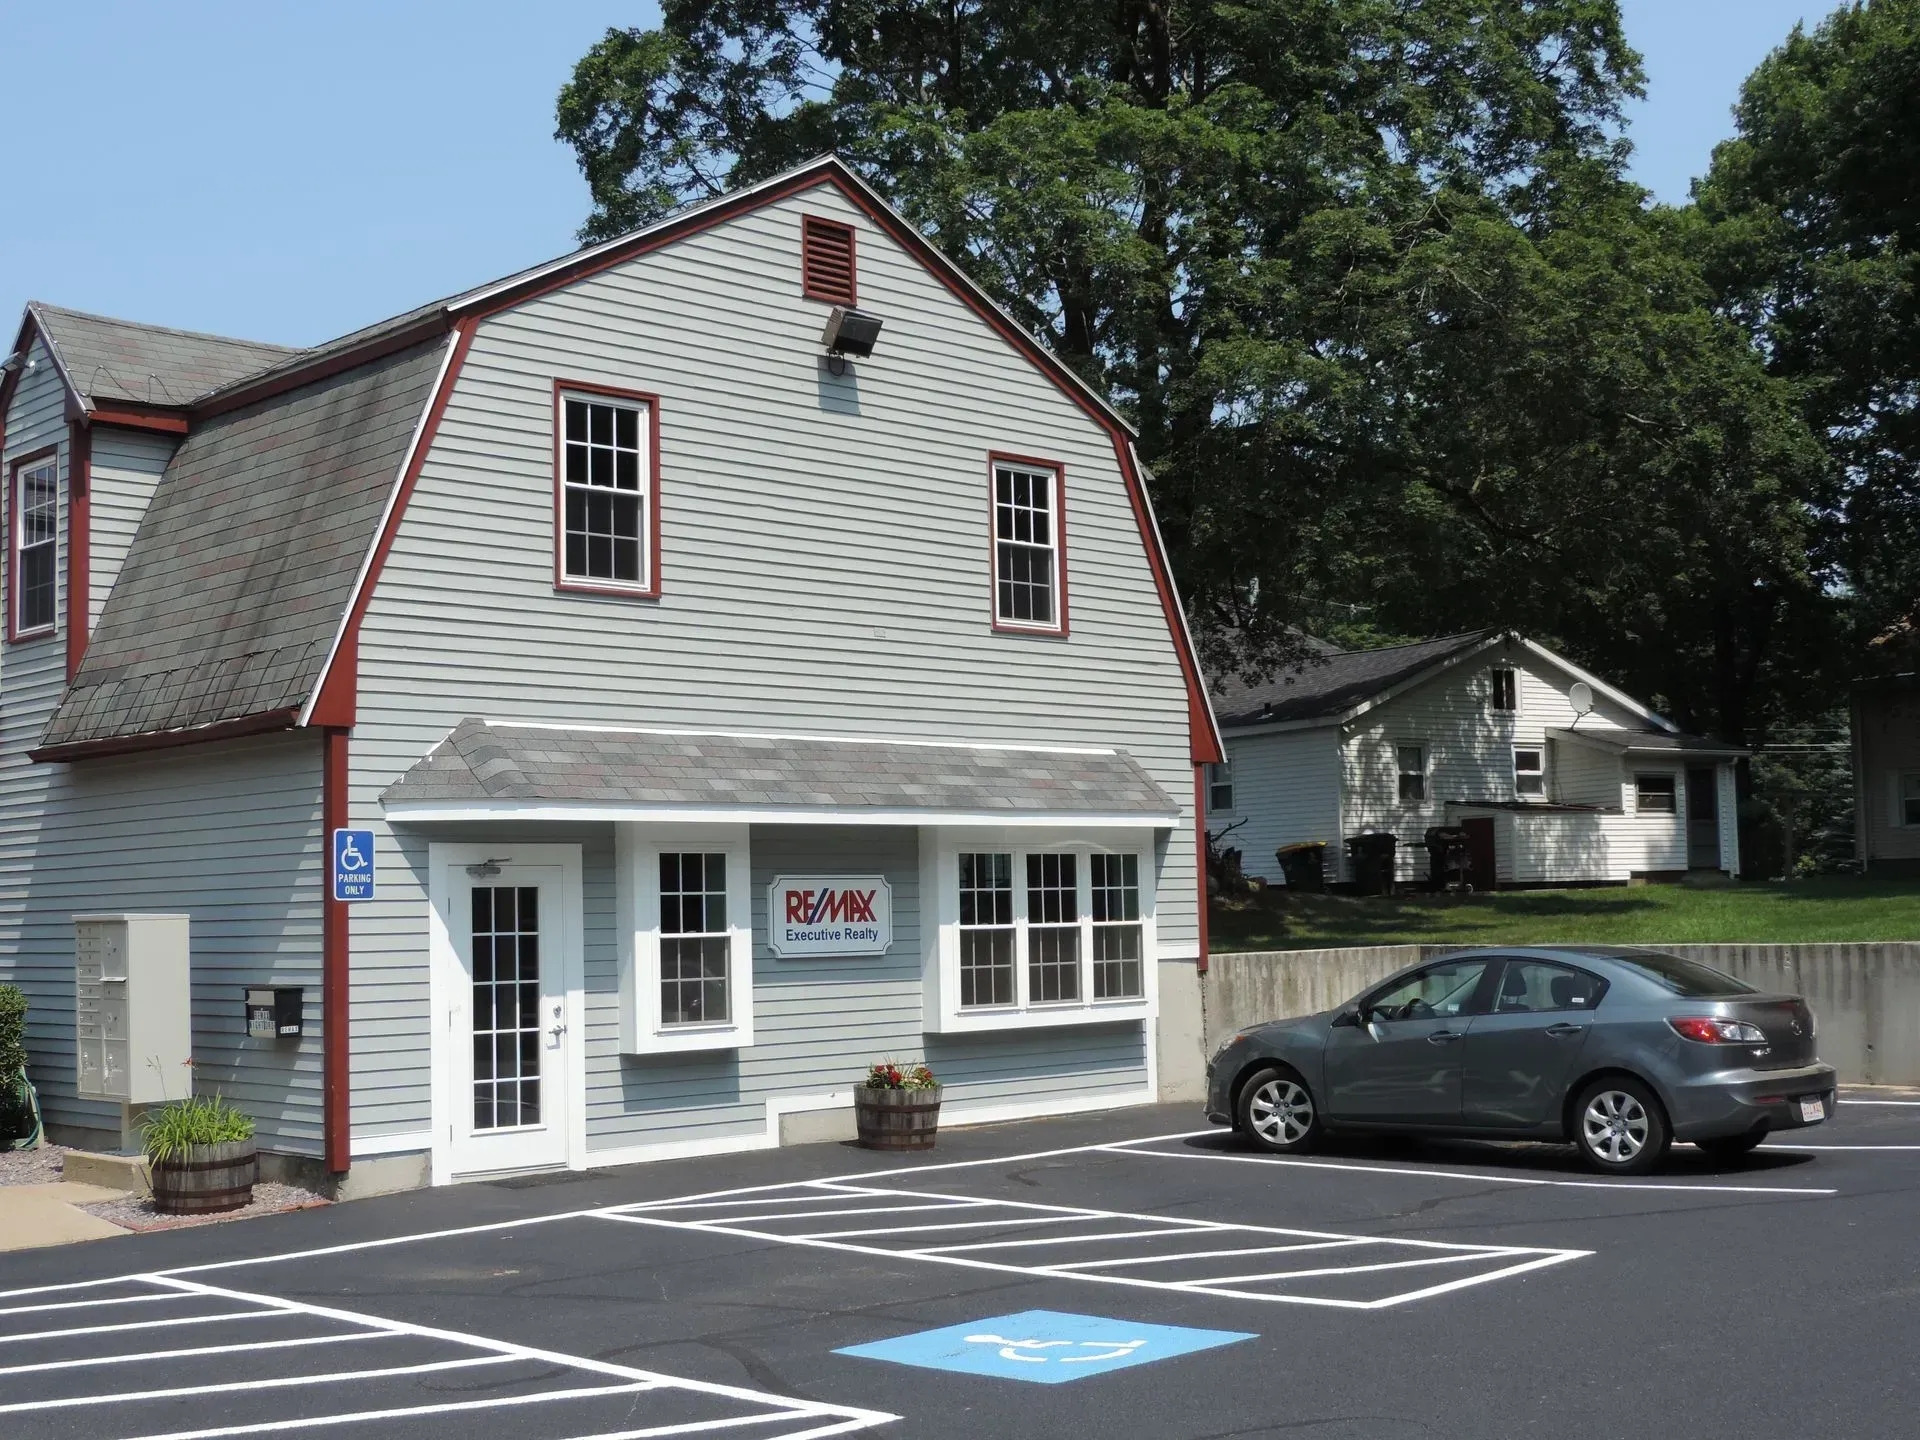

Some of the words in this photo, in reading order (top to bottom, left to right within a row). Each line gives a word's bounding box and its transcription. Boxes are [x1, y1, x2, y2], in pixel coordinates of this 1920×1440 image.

[338, 873, 371, 883] PARKING
[344, 885, 365, 895] ONLY
[785, 888, 877, 925] RE/MAX
[786, 928, 841, 941] Executive
[844, 927, 878, 942] Realty
